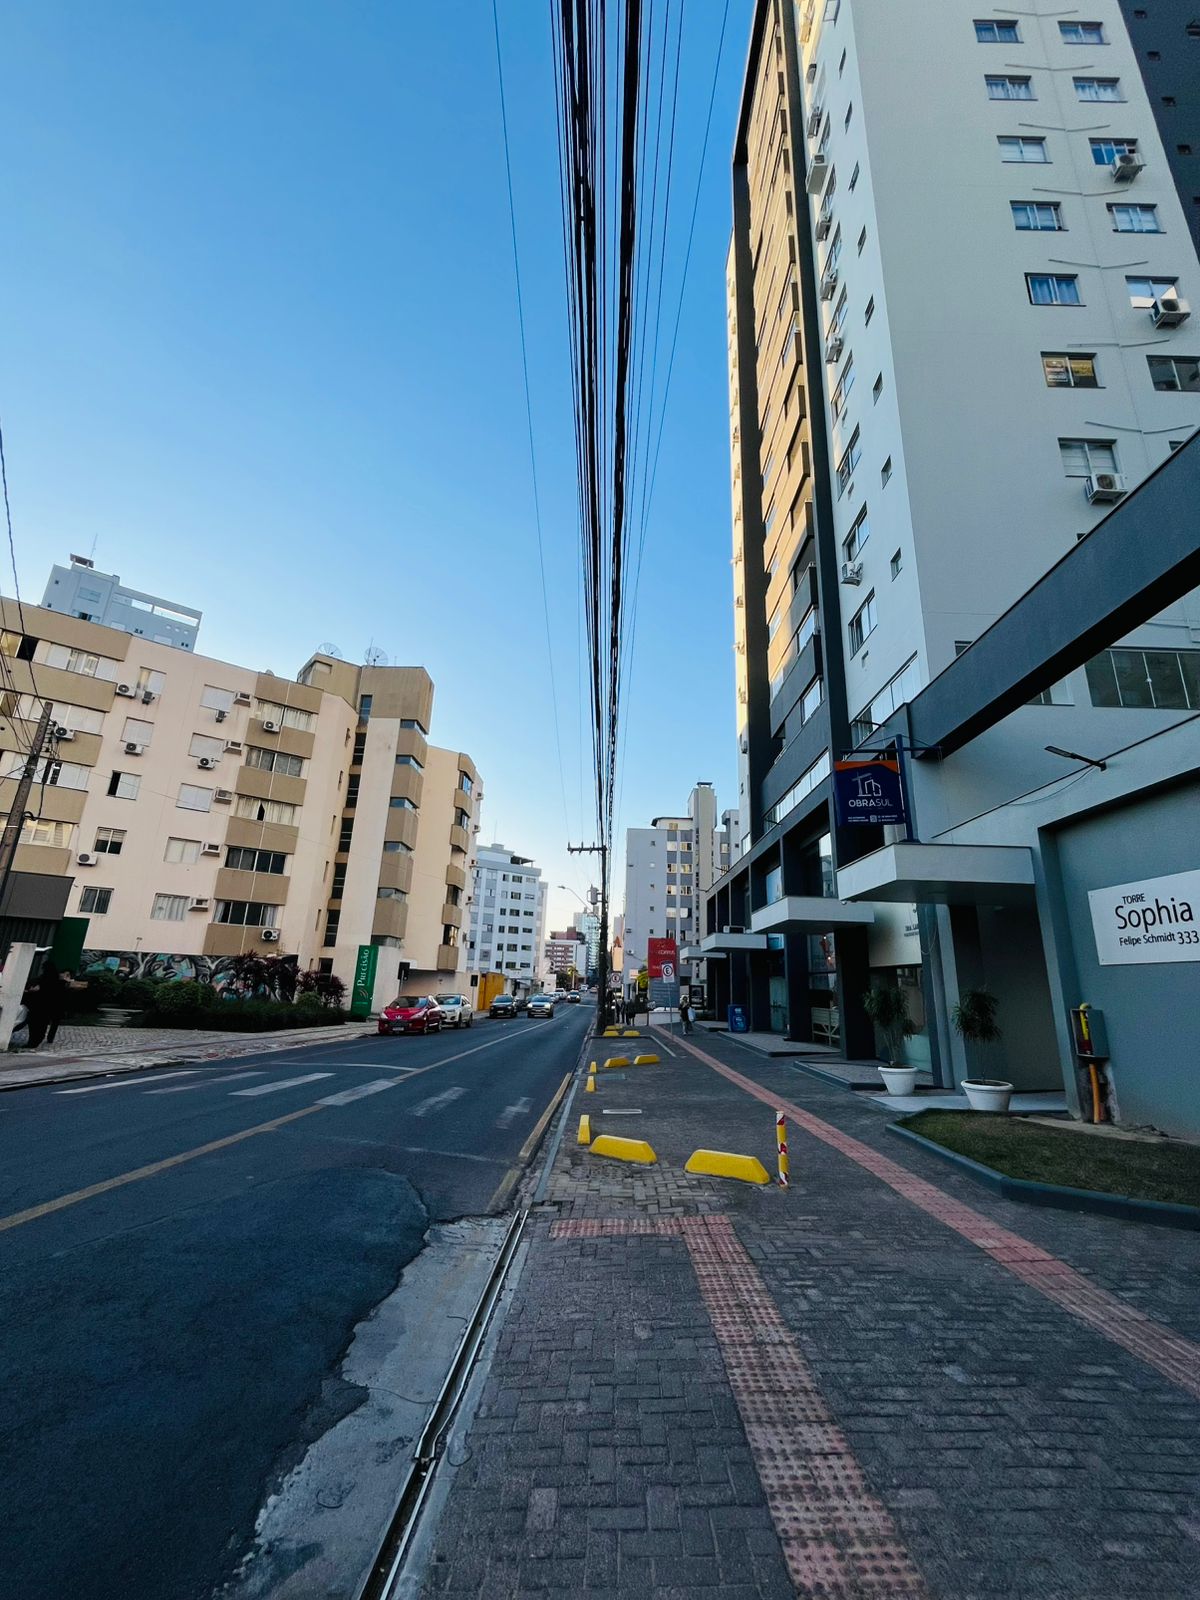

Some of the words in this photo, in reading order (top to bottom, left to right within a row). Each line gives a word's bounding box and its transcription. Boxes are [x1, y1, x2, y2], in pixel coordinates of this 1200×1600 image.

[848, 798, 893, 807] OBRASUL
[1122, 893, 1146, 904] TORRE
[1115, 897, 1194, 933] Sophia
[1119, 936, 1142, 947] Felipe
[1143, 932, 1176, 944] Schmidt
[1177, 930, 1199, 945] 333
